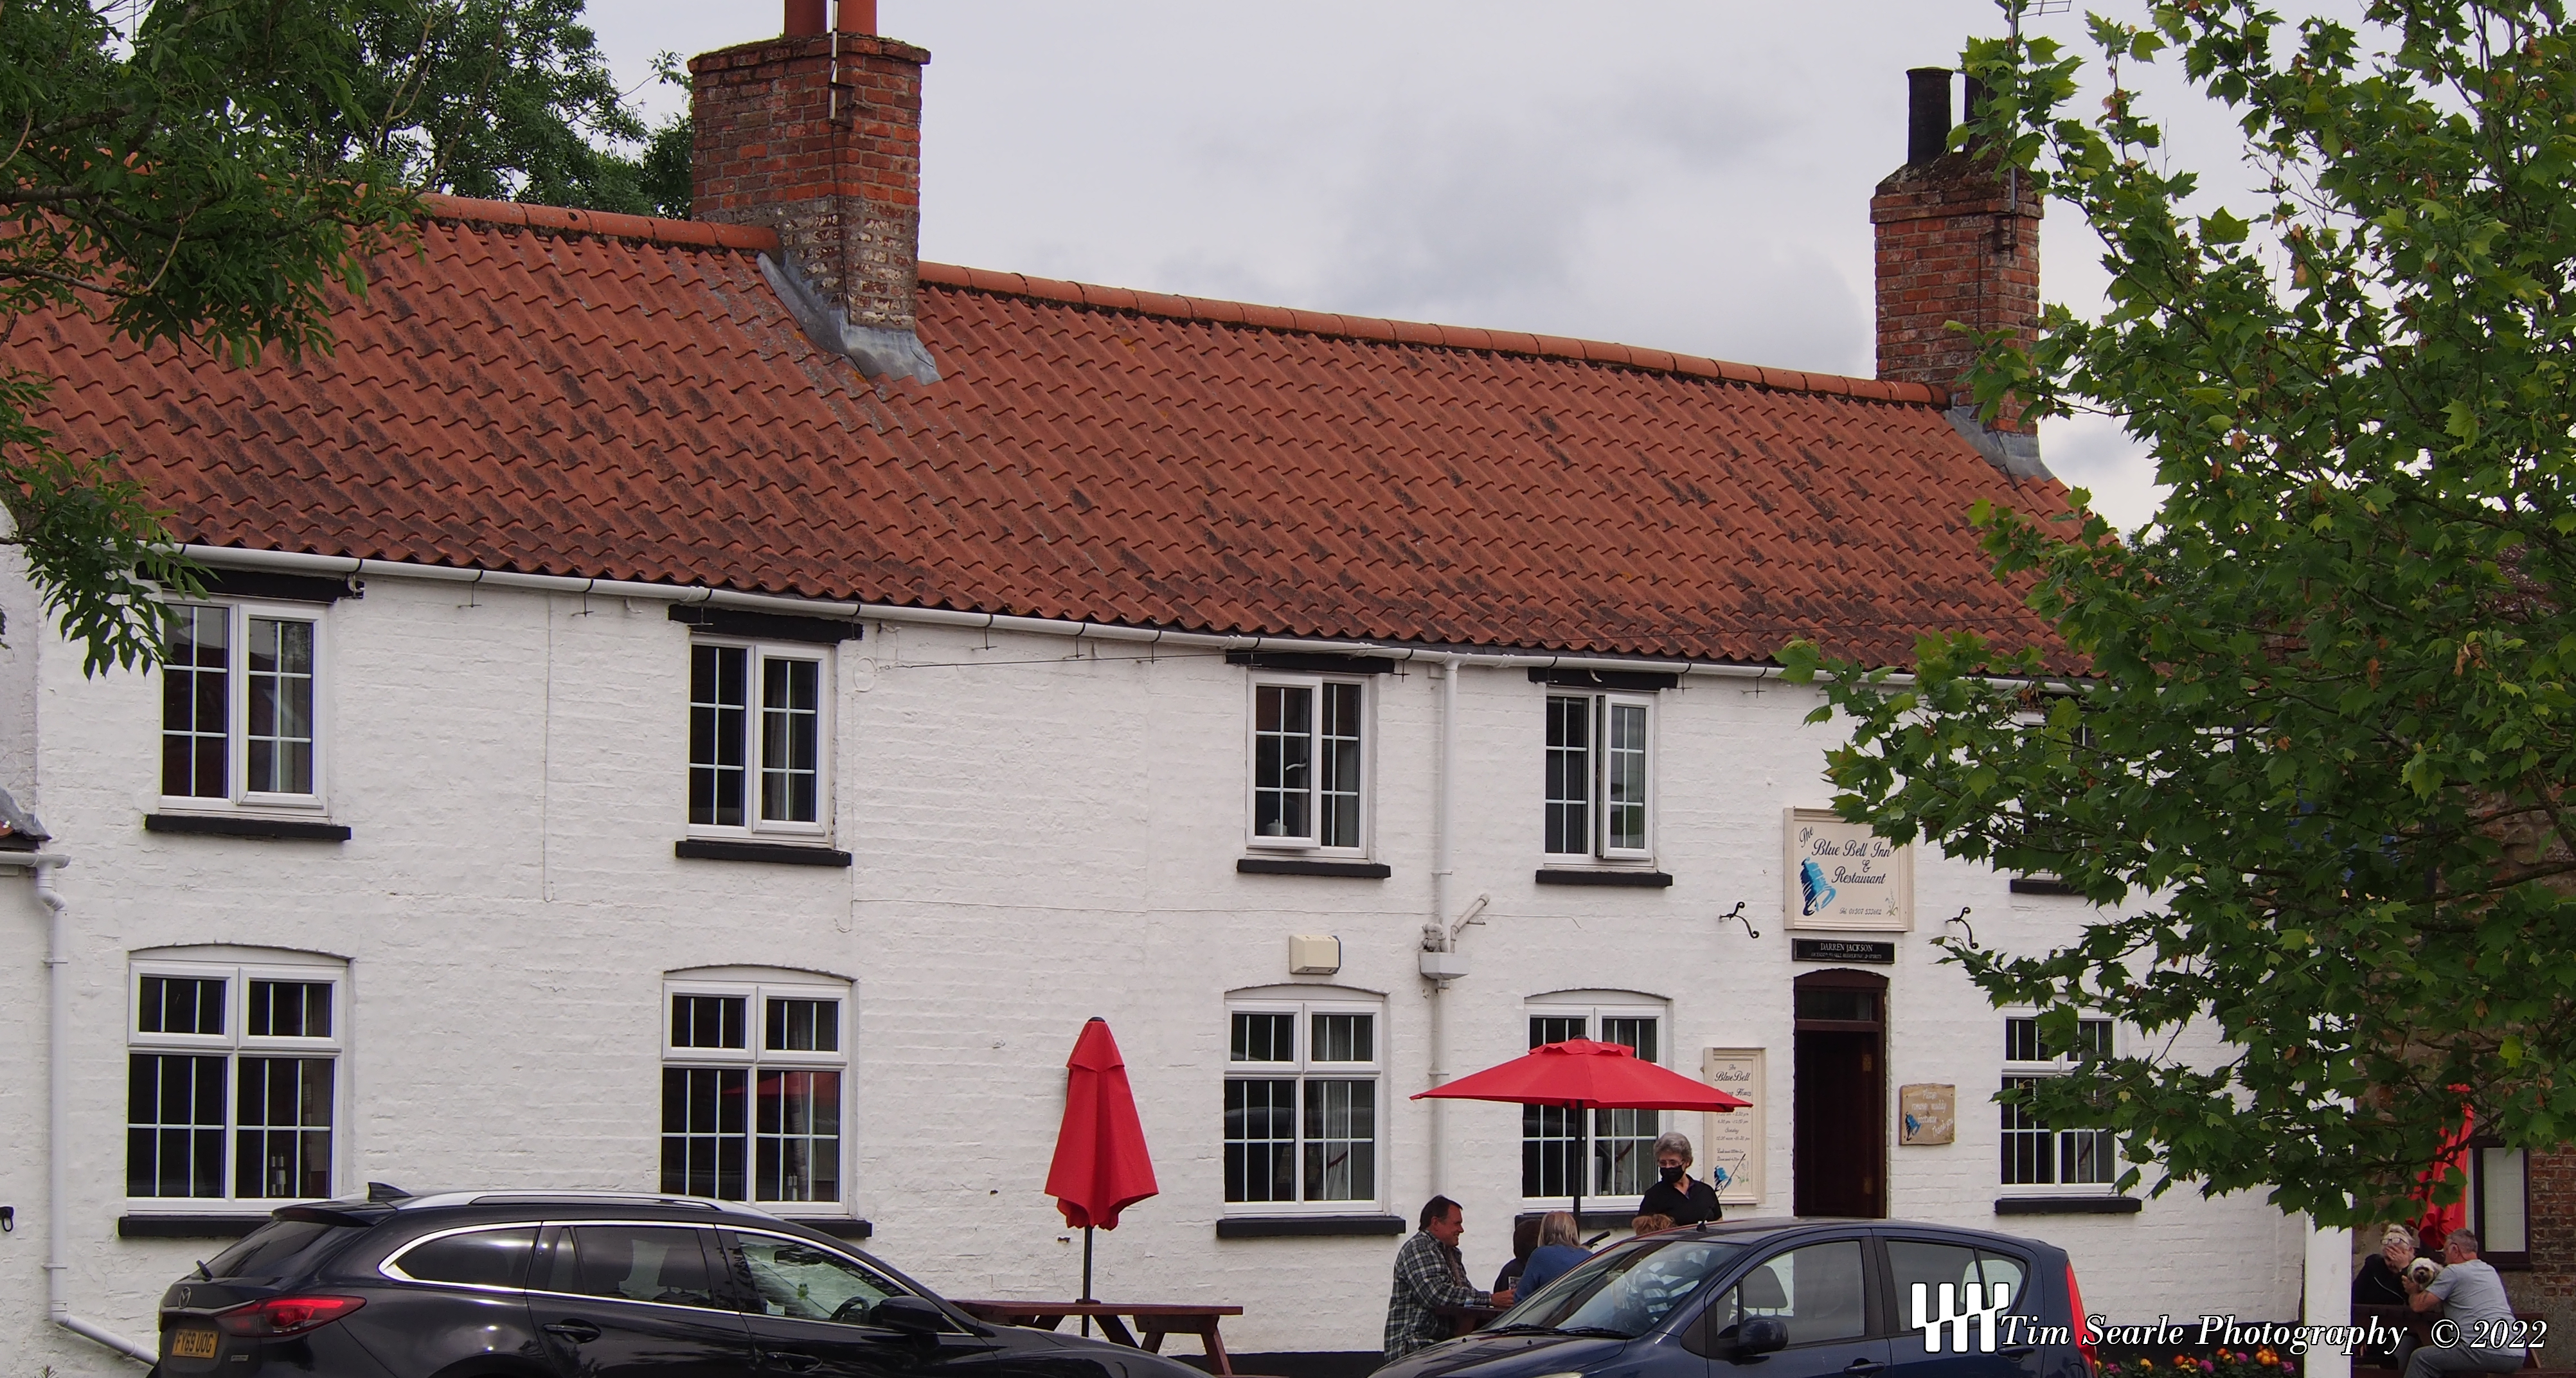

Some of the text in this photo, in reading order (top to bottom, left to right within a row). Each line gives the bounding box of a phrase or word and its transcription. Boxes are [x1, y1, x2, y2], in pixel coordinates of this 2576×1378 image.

[1799, 826, 1814, 848] The
[1811, 838, 1892, 858] Blue Bell Inn
[1831, 866, 1886, 884] Restaurant
[1862, 859, 1872, 873] &
[1820, 942, 1873, 952] DARREN JACKSON
[175, 1331, 214, 1354] FY69 UOG
